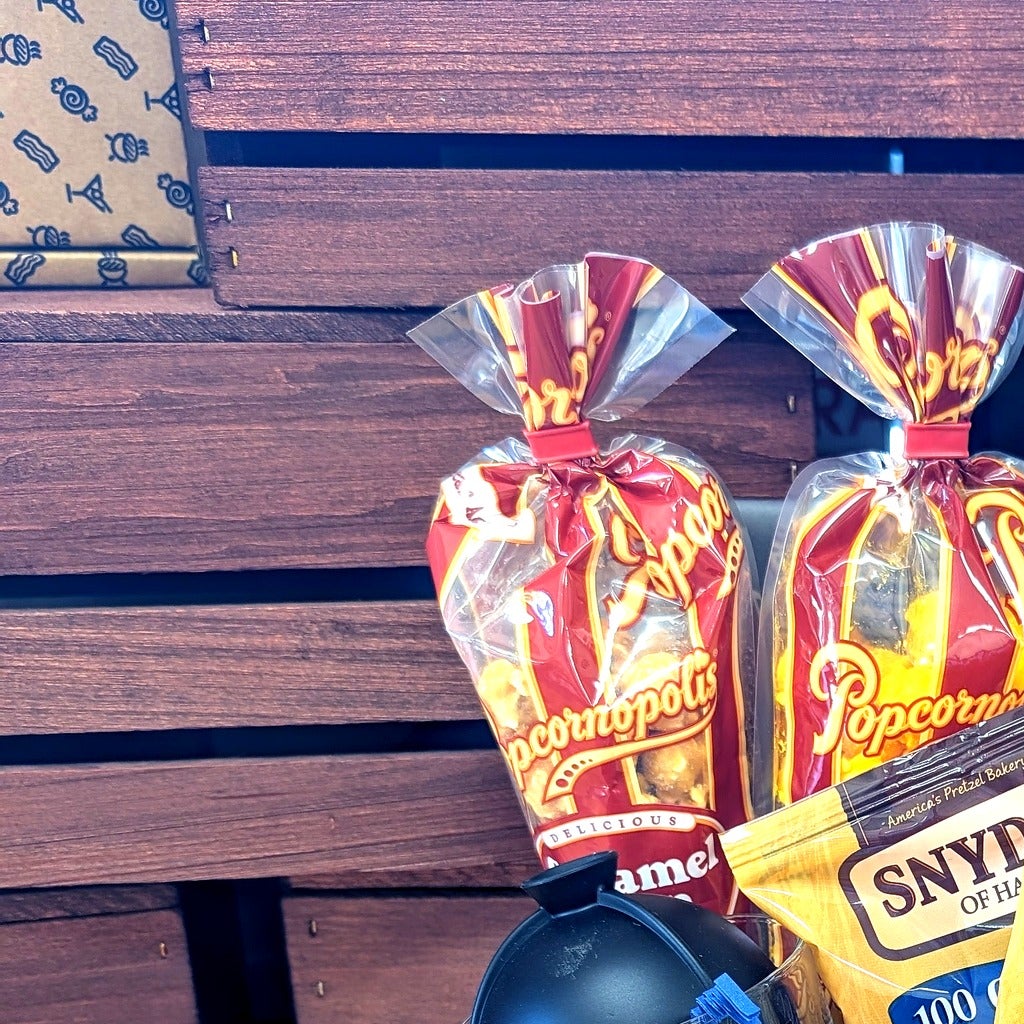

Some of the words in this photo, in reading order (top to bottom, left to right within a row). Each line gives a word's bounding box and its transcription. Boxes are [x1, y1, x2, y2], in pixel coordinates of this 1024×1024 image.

[507, 648, 717, 780] pcornopolis
[887, 795, 942, 828] America's
[944, 774, 986, 801] Pretzel
[550, 815, 677, 843] DELICIOUS
[615, 833, 719, 894] amel
[960, 891, 990, 915] OF
